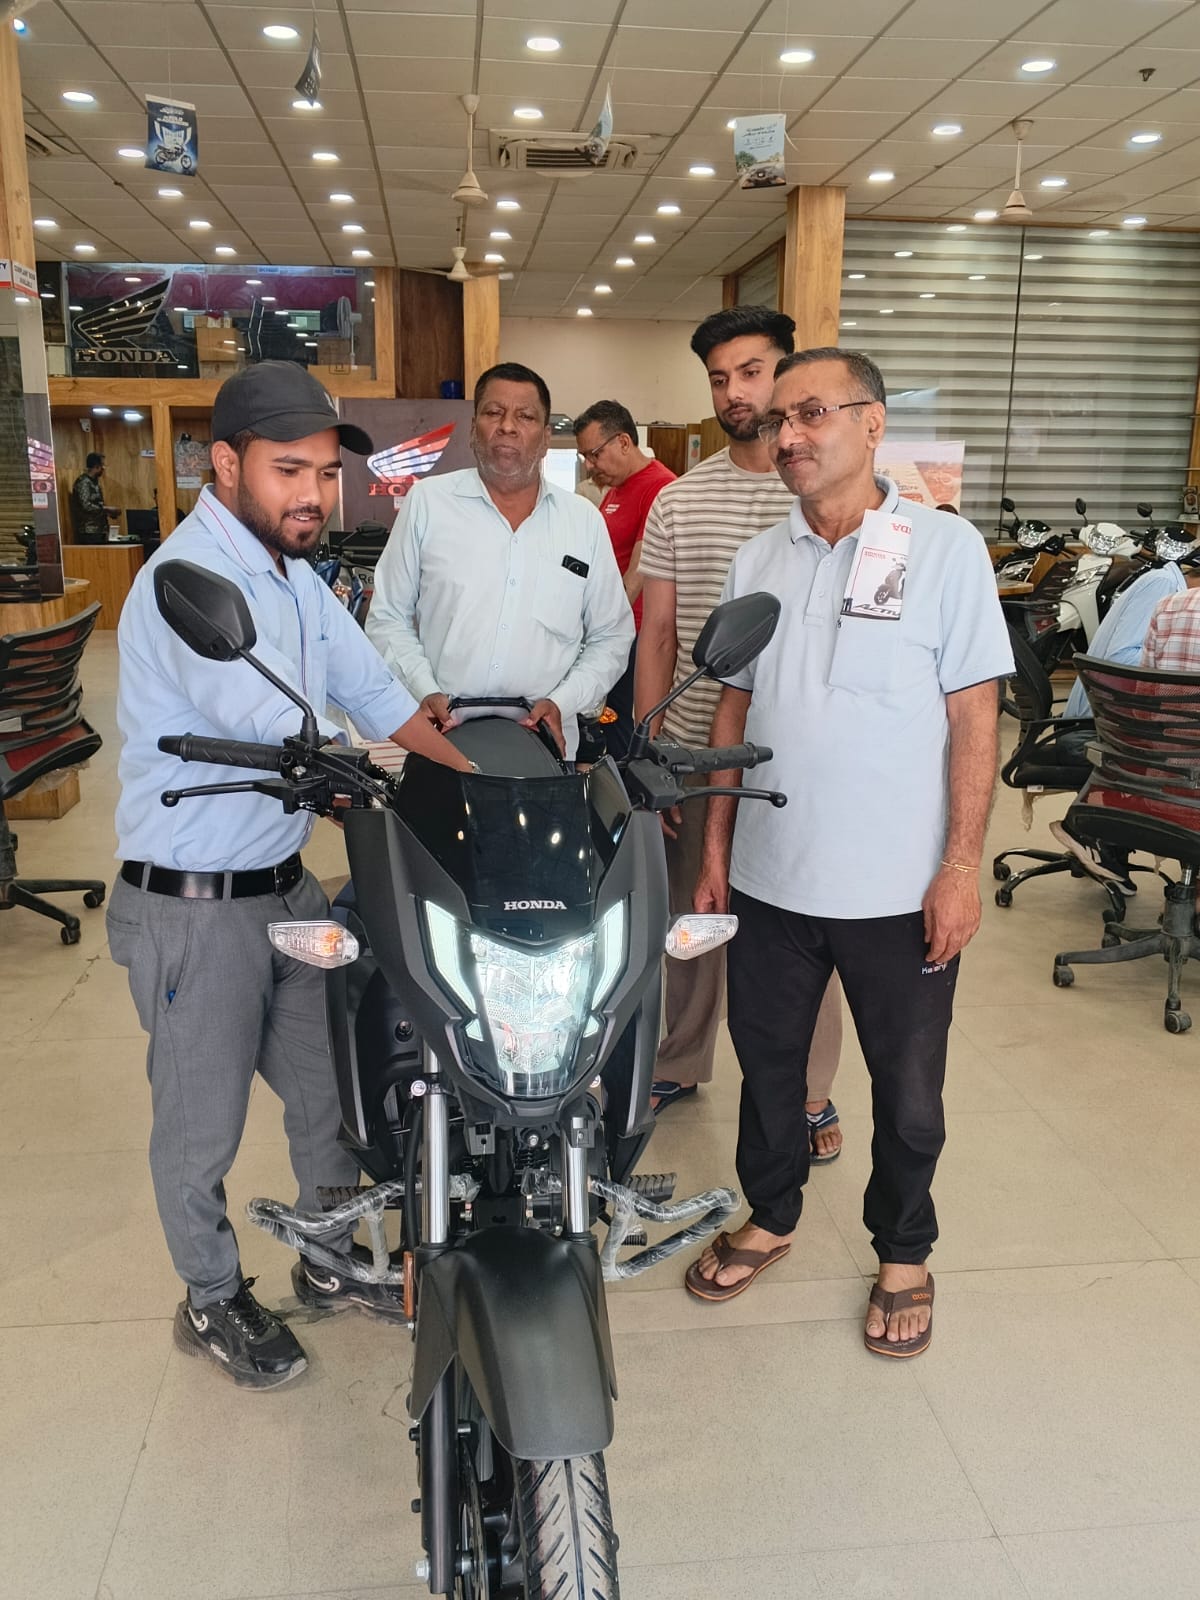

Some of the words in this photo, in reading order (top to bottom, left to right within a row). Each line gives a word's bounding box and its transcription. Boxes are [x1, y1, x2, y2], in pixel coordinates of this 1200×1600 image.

[77, 348, 178, 362] HONDA
[368, 483, 410, 496] HO
[504, 900, 567, 911] HONDA
